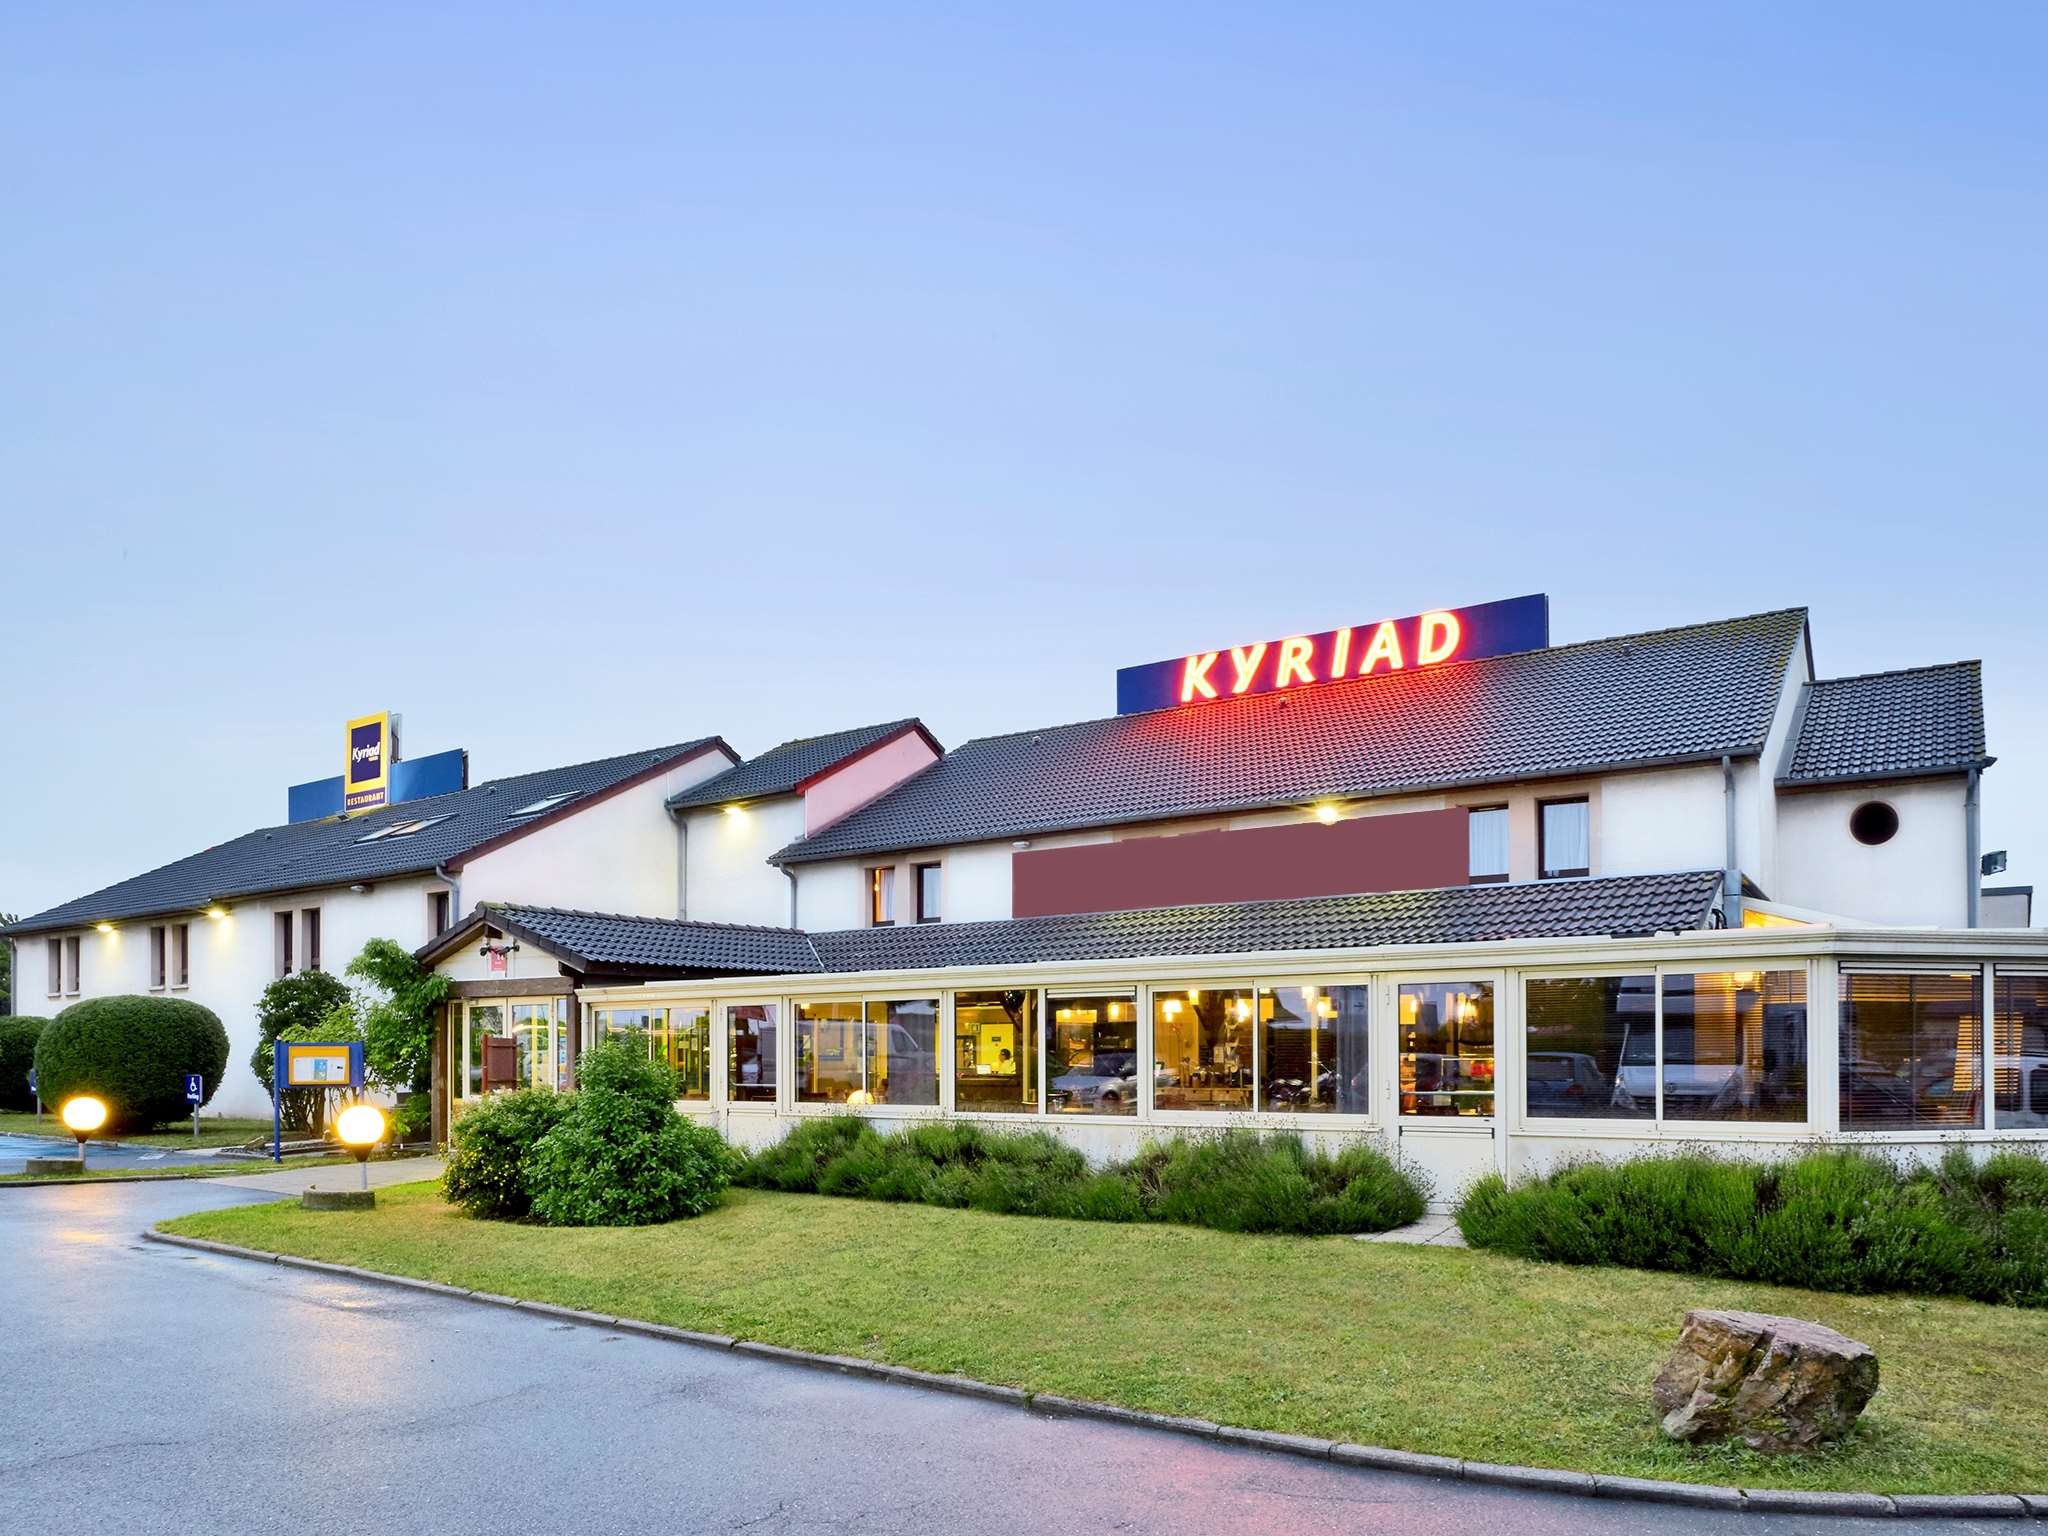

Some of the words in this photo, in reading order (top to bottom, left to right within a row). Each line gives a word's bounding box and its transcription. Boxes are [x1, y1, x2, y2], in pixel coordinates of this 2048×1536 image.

[1180, 610, 1461, 702] KYRIAD
[352, 741, 380, 762] Kyriad
[347, 791, 384, 806] RESTAURANT
